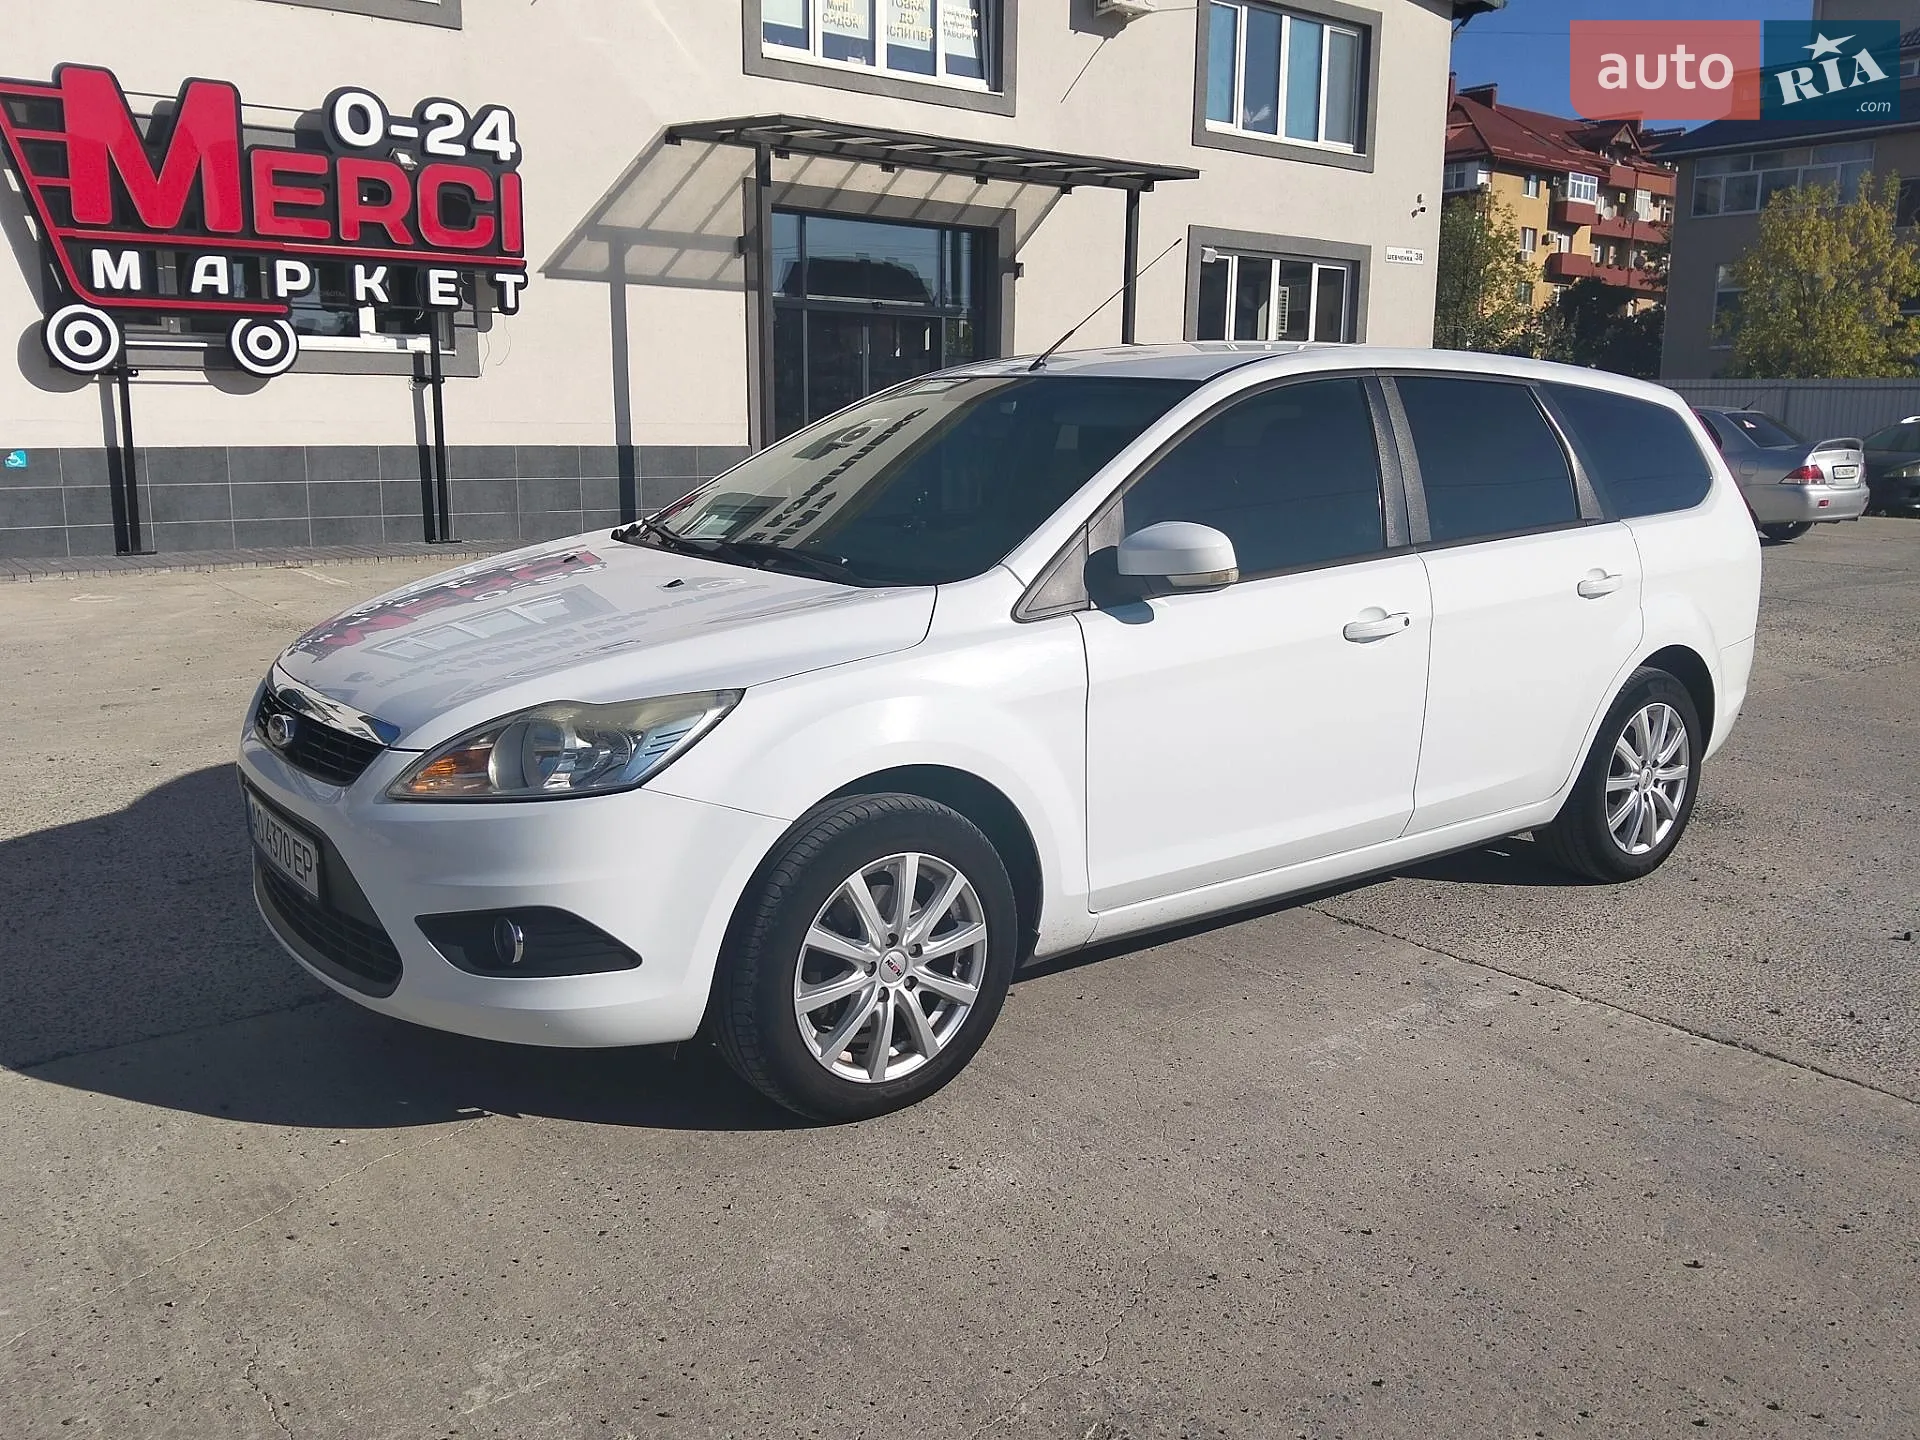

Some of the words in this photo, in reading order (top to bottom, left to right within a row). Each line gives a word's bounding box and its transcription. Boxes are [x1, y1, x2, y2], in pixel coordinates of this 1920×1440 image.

[60, 66, 523, 252] MERCI
[334, 91, 517, 161] 0-24
[91, 248, 525, 309] МАРКЕТ
[1414, 252, 1423, 262] 38
[265, 816, 292, 869] 4370
[292, 837, 313, 883] EP
